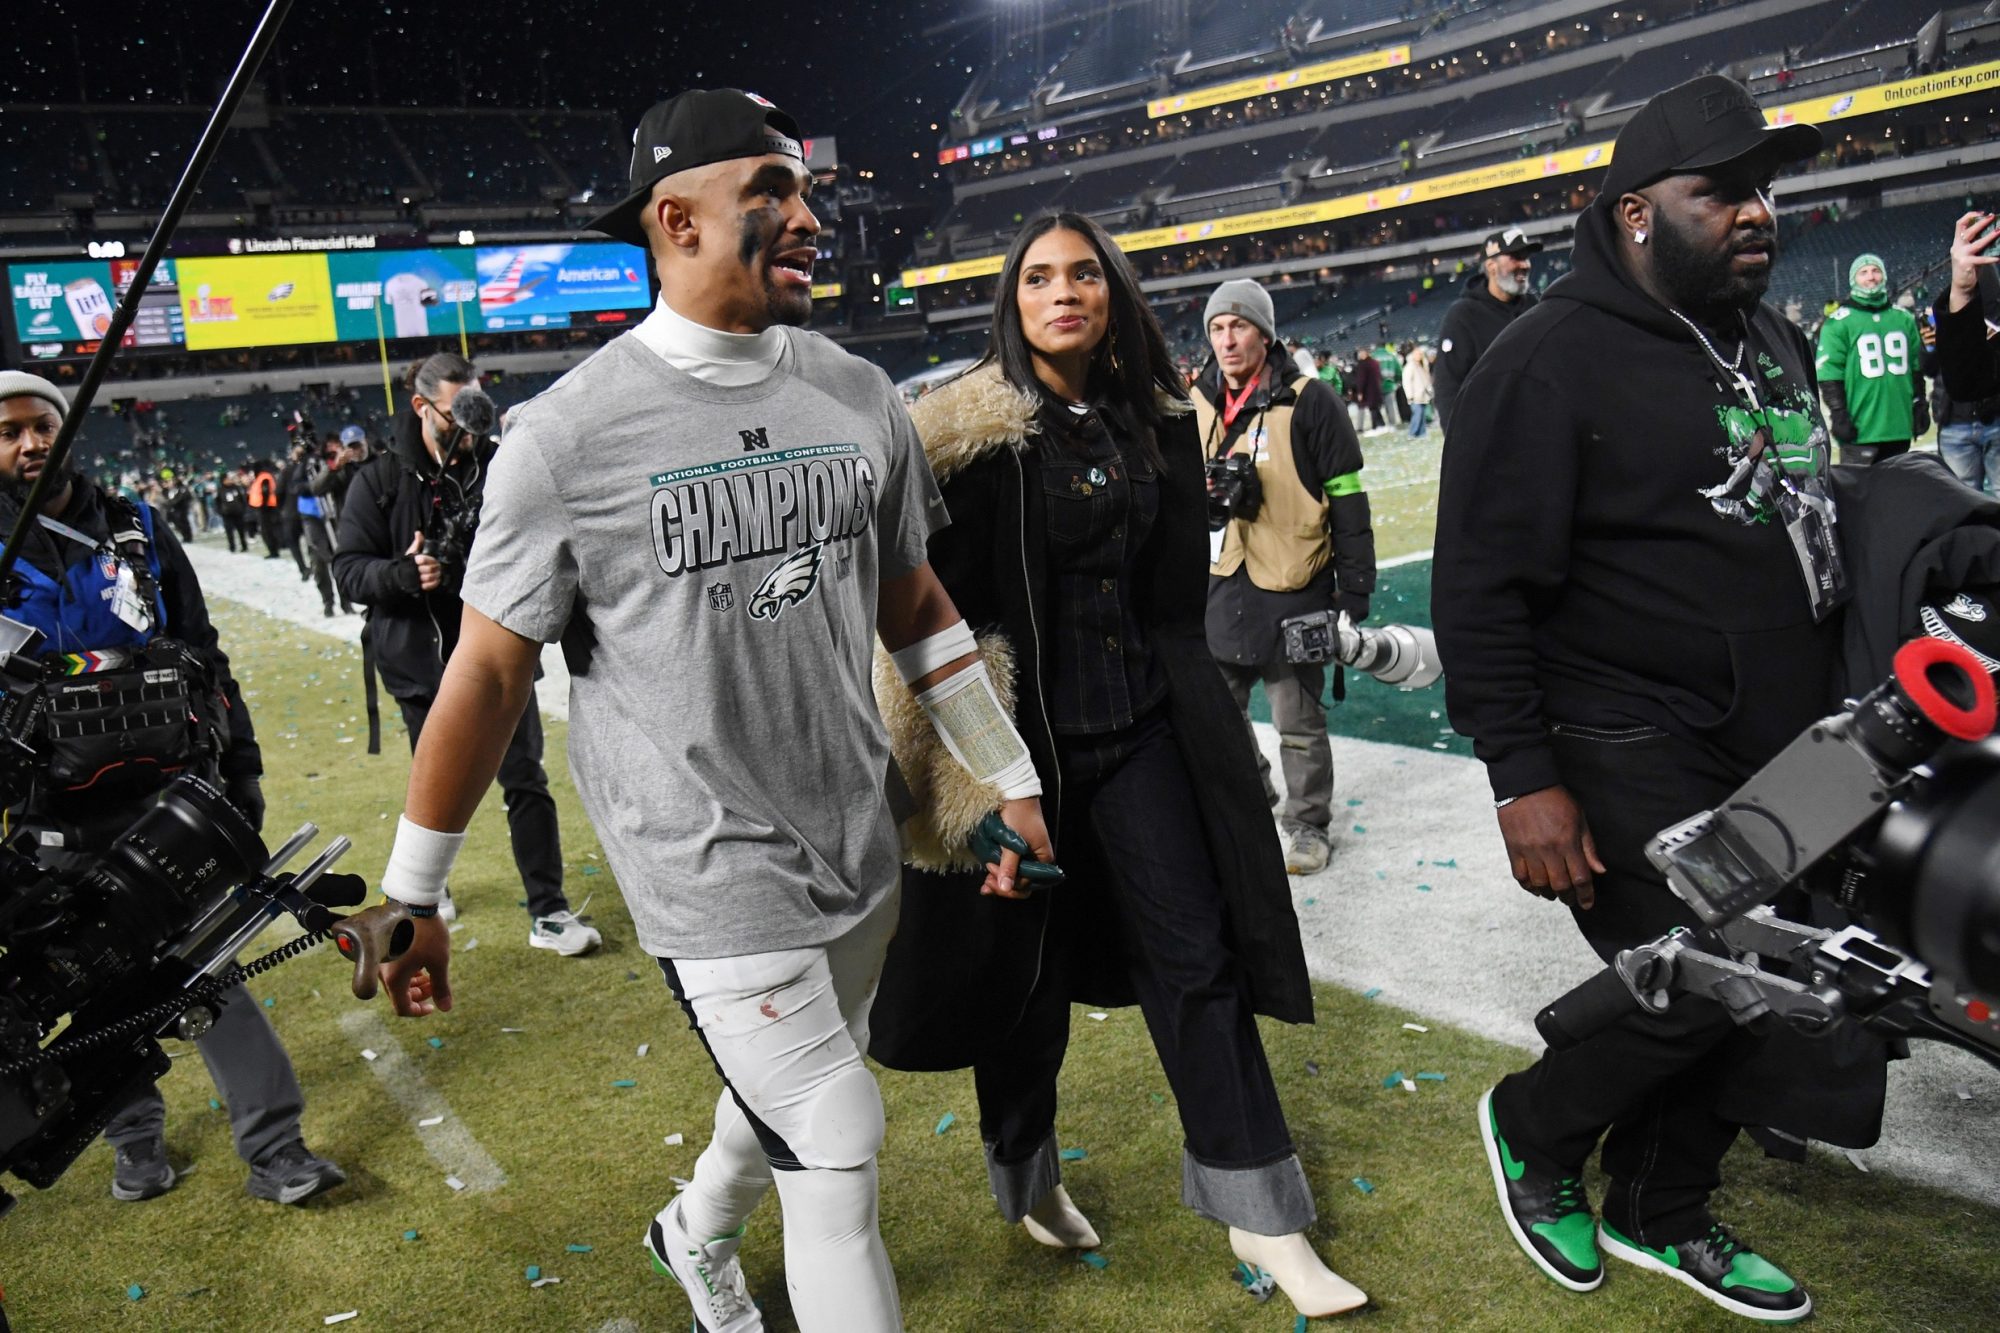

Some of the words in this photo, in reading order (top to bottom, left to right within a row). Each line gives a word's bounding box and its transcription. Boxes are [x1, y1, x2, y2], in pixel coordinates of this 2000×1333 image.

[245, 237, 292, 252] Lincoln
[292, 235, 347, 251] Financial
[346, 234, 376, 249] Field
[557, 267, 620, 283] American
[1857, 331, 1908, 379] 89
[738, 427, 770, 452] N
[657, 465, 718, 484] NATIONAL
[720, 452, 781, 470] FOOTBALL
[784, 444, 856, 460] CONFERENCE
[650, 456, 875, 578] CHAMPIONS
[711, 594, 732, 609] NFL
[195, 857, 217, 878] 19-90
